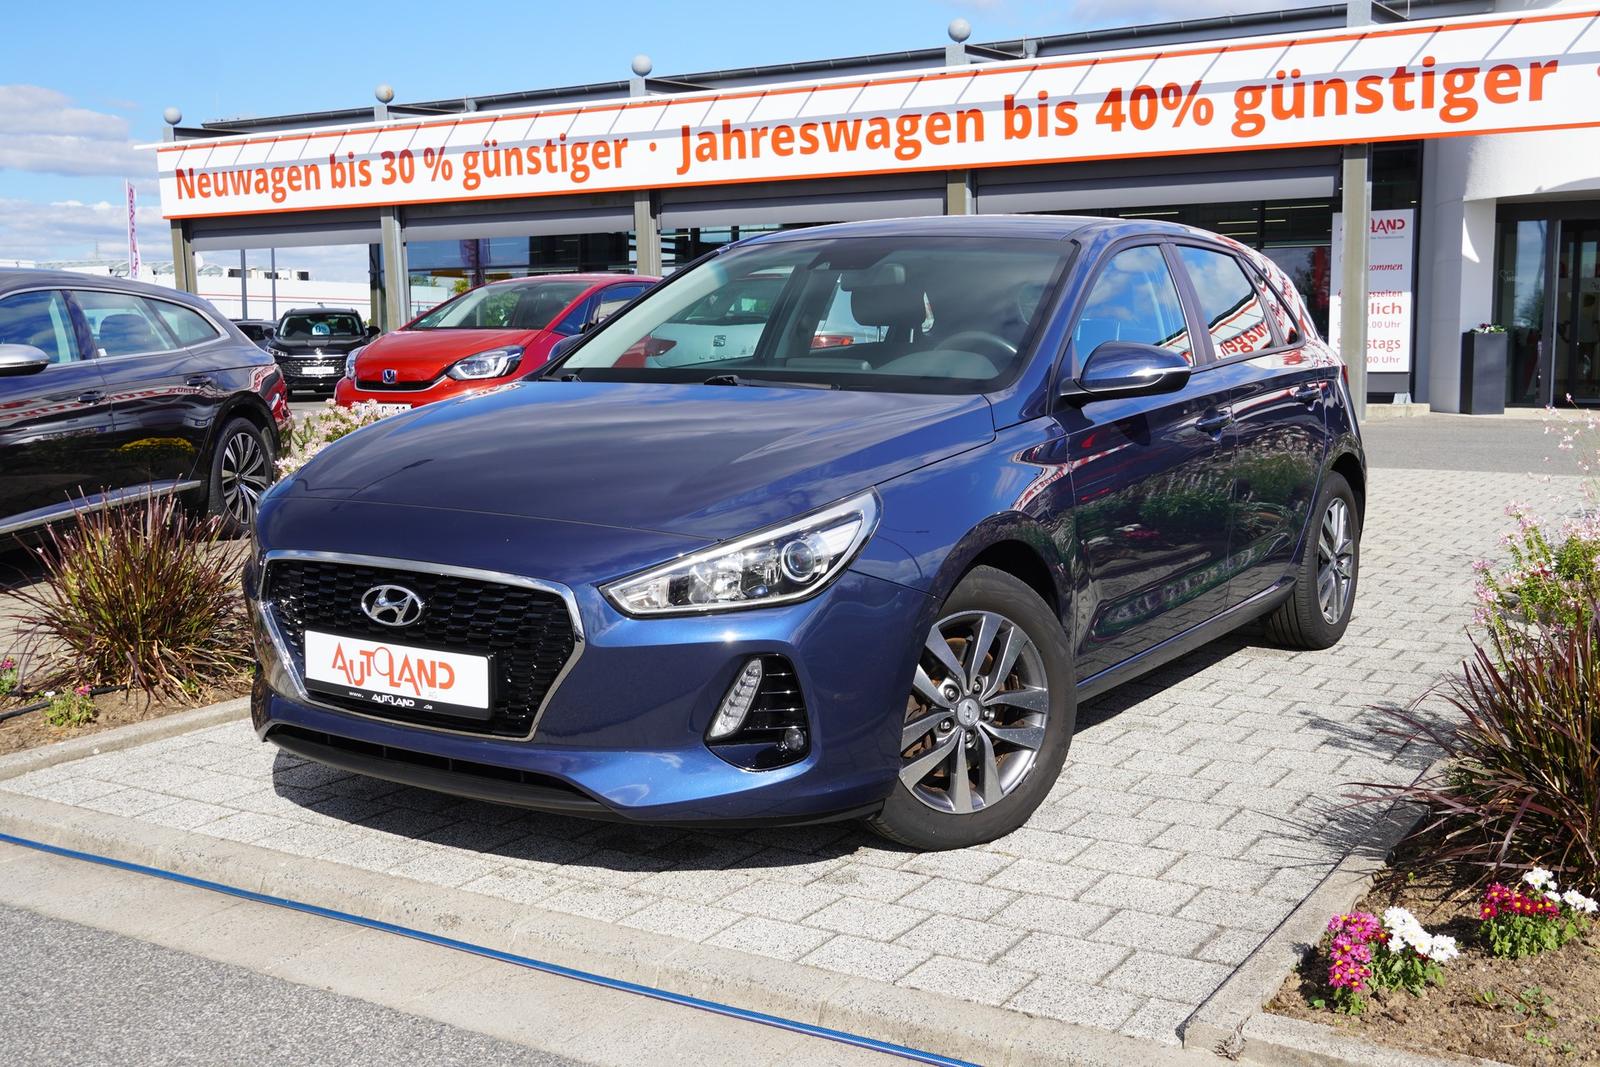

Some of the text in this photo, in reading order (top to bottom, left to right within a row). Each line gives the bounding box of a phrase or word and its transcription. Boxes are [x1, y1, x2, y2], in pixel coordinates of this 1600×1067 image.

[175, 55, 1559, 204] Neuwagen bis 30 % günstiger Jahreswagen bis 40% günstiger
[1371, 218, 1406, 234] LAND
[1369, 263, 1403, 271] ommen
[1370, 302, 1403, 315] lich
[1384, 320, 1401, 329] Uhr
[1367, 338, 1401, 353] stags
[1381, 355, 1401, 364] Uhr
